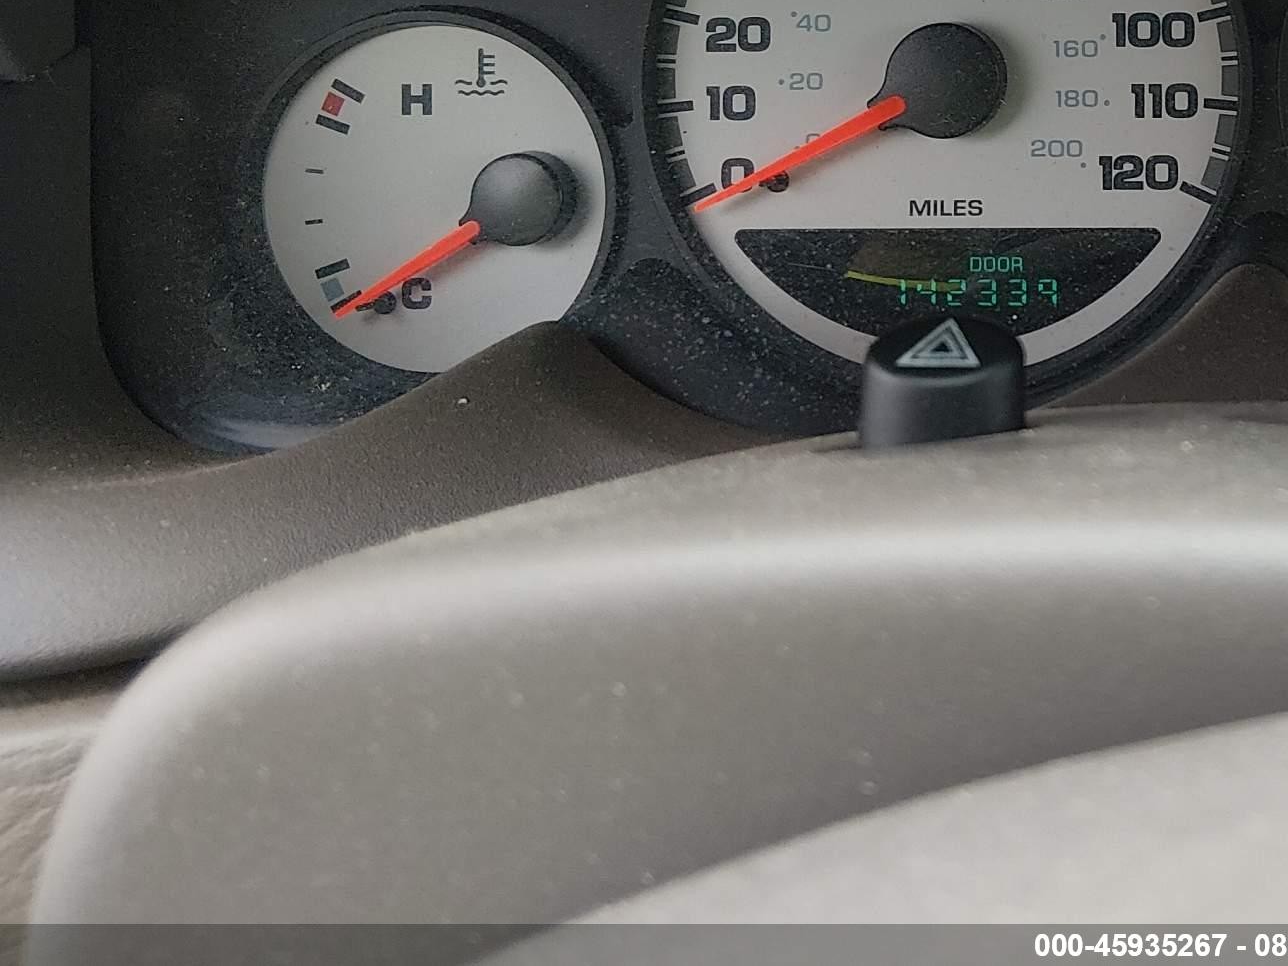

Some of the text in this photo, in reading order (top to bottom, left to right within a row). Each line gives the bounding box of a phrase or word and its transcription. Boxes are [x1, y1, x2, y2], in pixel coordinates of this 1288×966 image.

[705, 17, 772, 53] 20
[796, 13, 832, 33] 40
[1112, 12, 1196, 47] 100
[1053, 40, 1099, 59] 160
[789, 72, 824, 91] 20
[401, 83, 433, 116] H
[705, 85, 757, 121] 10
[1055, 89, 1099, 108] 180
[1131, 83, 1199, 119] 110
[1030, 139, 1083, 158] 200
[1099, 155, 1179, 191] 120
[908, 199, 984, 218] MILES
[969, 256, 1024, 273] DOOR
[401, 277, 432, 310] C
[899, 278, 1058, 307] 142339
